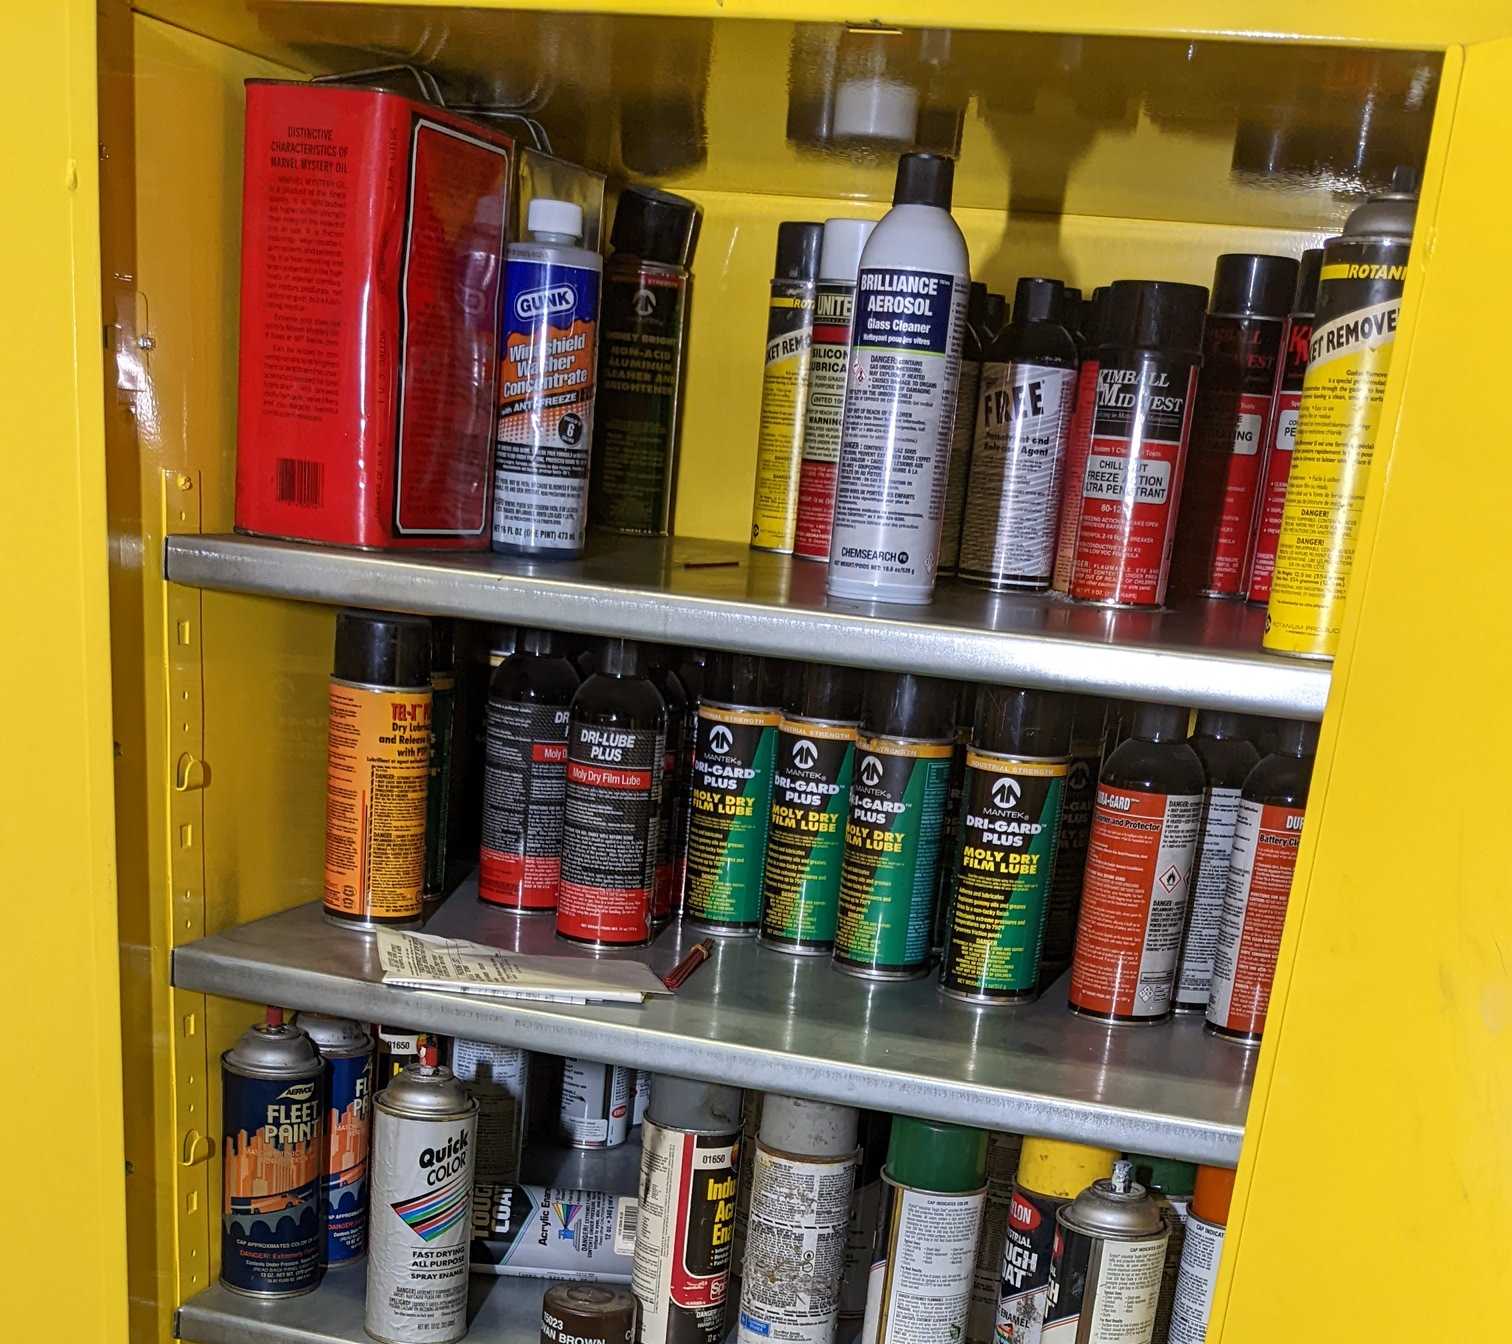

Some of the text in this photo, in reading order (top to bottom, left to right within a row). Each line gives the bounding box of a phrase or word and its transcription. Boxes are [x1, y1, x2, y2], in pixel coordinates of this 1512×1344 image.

[288, 127, 333, 141] DISTINCTIVE
[271, 141, 337, 157] CHARACTERISTICS
[271, 157, 348, 174] MARVEL MYSTERY OIL
[861, 273, 938, 296] BRILLIANCE
[520, 290, 571, 313] GUNK
[867, 295, 933, 316] AEROSOL
[868, 318, 931, 334] Glass Cleaner
[1097, 369, 1170, 388] KIMBALL
[1099, 383, 1183, 413] MIDWEST
[1021, 447, 1049, 458] Agent
[1099, 460, 1123, 471] CHILL
[1087, 470, 1119, 483] FREEZE
[1301, 509, 1330, 518] DANGER!
[1296, 537, 1325, 546] DANGER!
[841, 546, 897, 562] CHEMSEARCH
[392, 722, 407, 734] Dry
[379, 734, 397, 744] and
[580, 729, 636, 748] DRI-LUBE
[397, 747, 415, 757] with
[544, 749, 561, 760] Moly
[590, 746, 622, 761] PLUS
[704, 752, 737, 765] MANTEK
[573, 767, 641, 785] Moly Dry Film Lube
[693, 759, 755, 779] DRI-GARD
[786, 766, 821, 780] MANTEK
[704, 775, 738, 790] PLUS
[774, 774, 840, 795] DRI-GARD
[855, 784, 886, 797] MANTEK
[693, 789, 755, 807] MOLY DRY
[786, 791, 822, 806] PLUS
[692, 799, 753, 816] FILM LUBE
[772, 803, 839, 823] MOLY DRY
[983, 807, 1024, 819] MANTEK
[772, 814, 837, 833] FILM LUBE
[854, 808, 886, 824] PLUS
[966, 815, 1041, 835] DRI-GARD
[1111, 819, 1160, 832] and Protector
[873, 830, 905, 843] DRY
[982, 831, 1023, 847] PLUS
[1259, 833, 1287, 847] Battery
[866, 839, 902, 853] LUBE
[964, 846, 1040, 865] MOLY DRY
[963, 857, 1037, 875] FILM LUBE
[267, 1101, 320, 1123] FLEET
[264, 1119, 320, 1145] PAINT
[419, 1129, 469, 1169] Quick
[702, 1154, 725, 1164] 01650
[426, 1151, 467, 1186] COLOR
[538, 1210, 551, 1246] Acrylic
[436, 1246, 465, 1257] DRYING
[430, 1255, 465, 1268] PURPOSE
